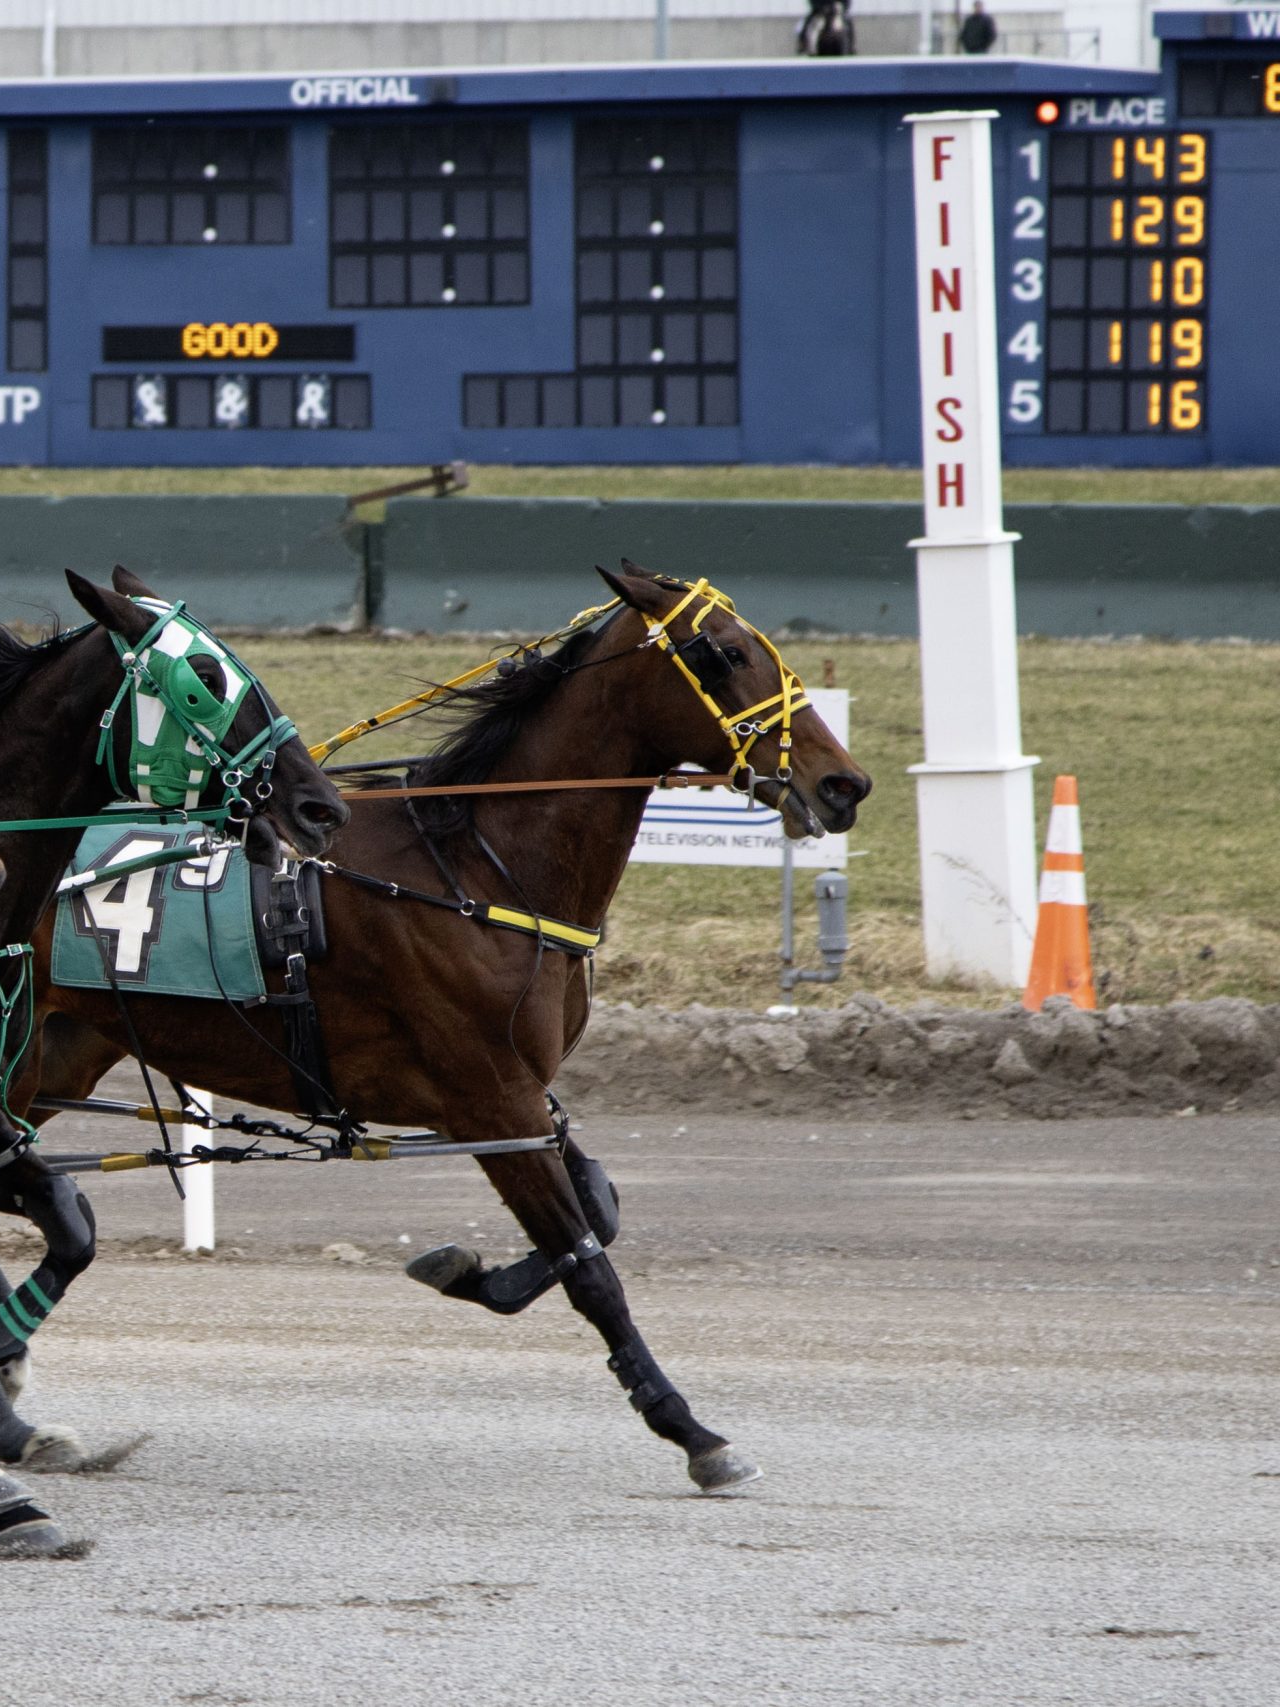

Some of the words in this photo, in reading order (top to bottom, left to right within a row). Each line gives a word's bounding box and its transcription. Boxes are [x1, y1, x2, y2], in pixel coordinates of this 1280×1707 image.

[290, 78, 419, 105] OFFICIAL
[1069, 99, 1166, 125] PLACE
[1020, 140, 1041, 181] 1
[1112, 134, 1206, 183] 143
[1014, 196, 1045, 239] 2
[1111, 196, 1205, 245] 129
[1011, 258, 1043, 301] 3
[1150, 256, 1204, 306] 10
[181, 322, 279, 358] GOOD
[931, 136, 965, 508] FINISH
[1007, 321, 1042, 364] 4
[1109, 318, 1203, 368] 119
[1007, 380, 1042, 423] 5
[1148, 380, 1201, 429] 16
[638, 831, 727, 848] TELEVISION
[80, 839, 165, 973] 4
